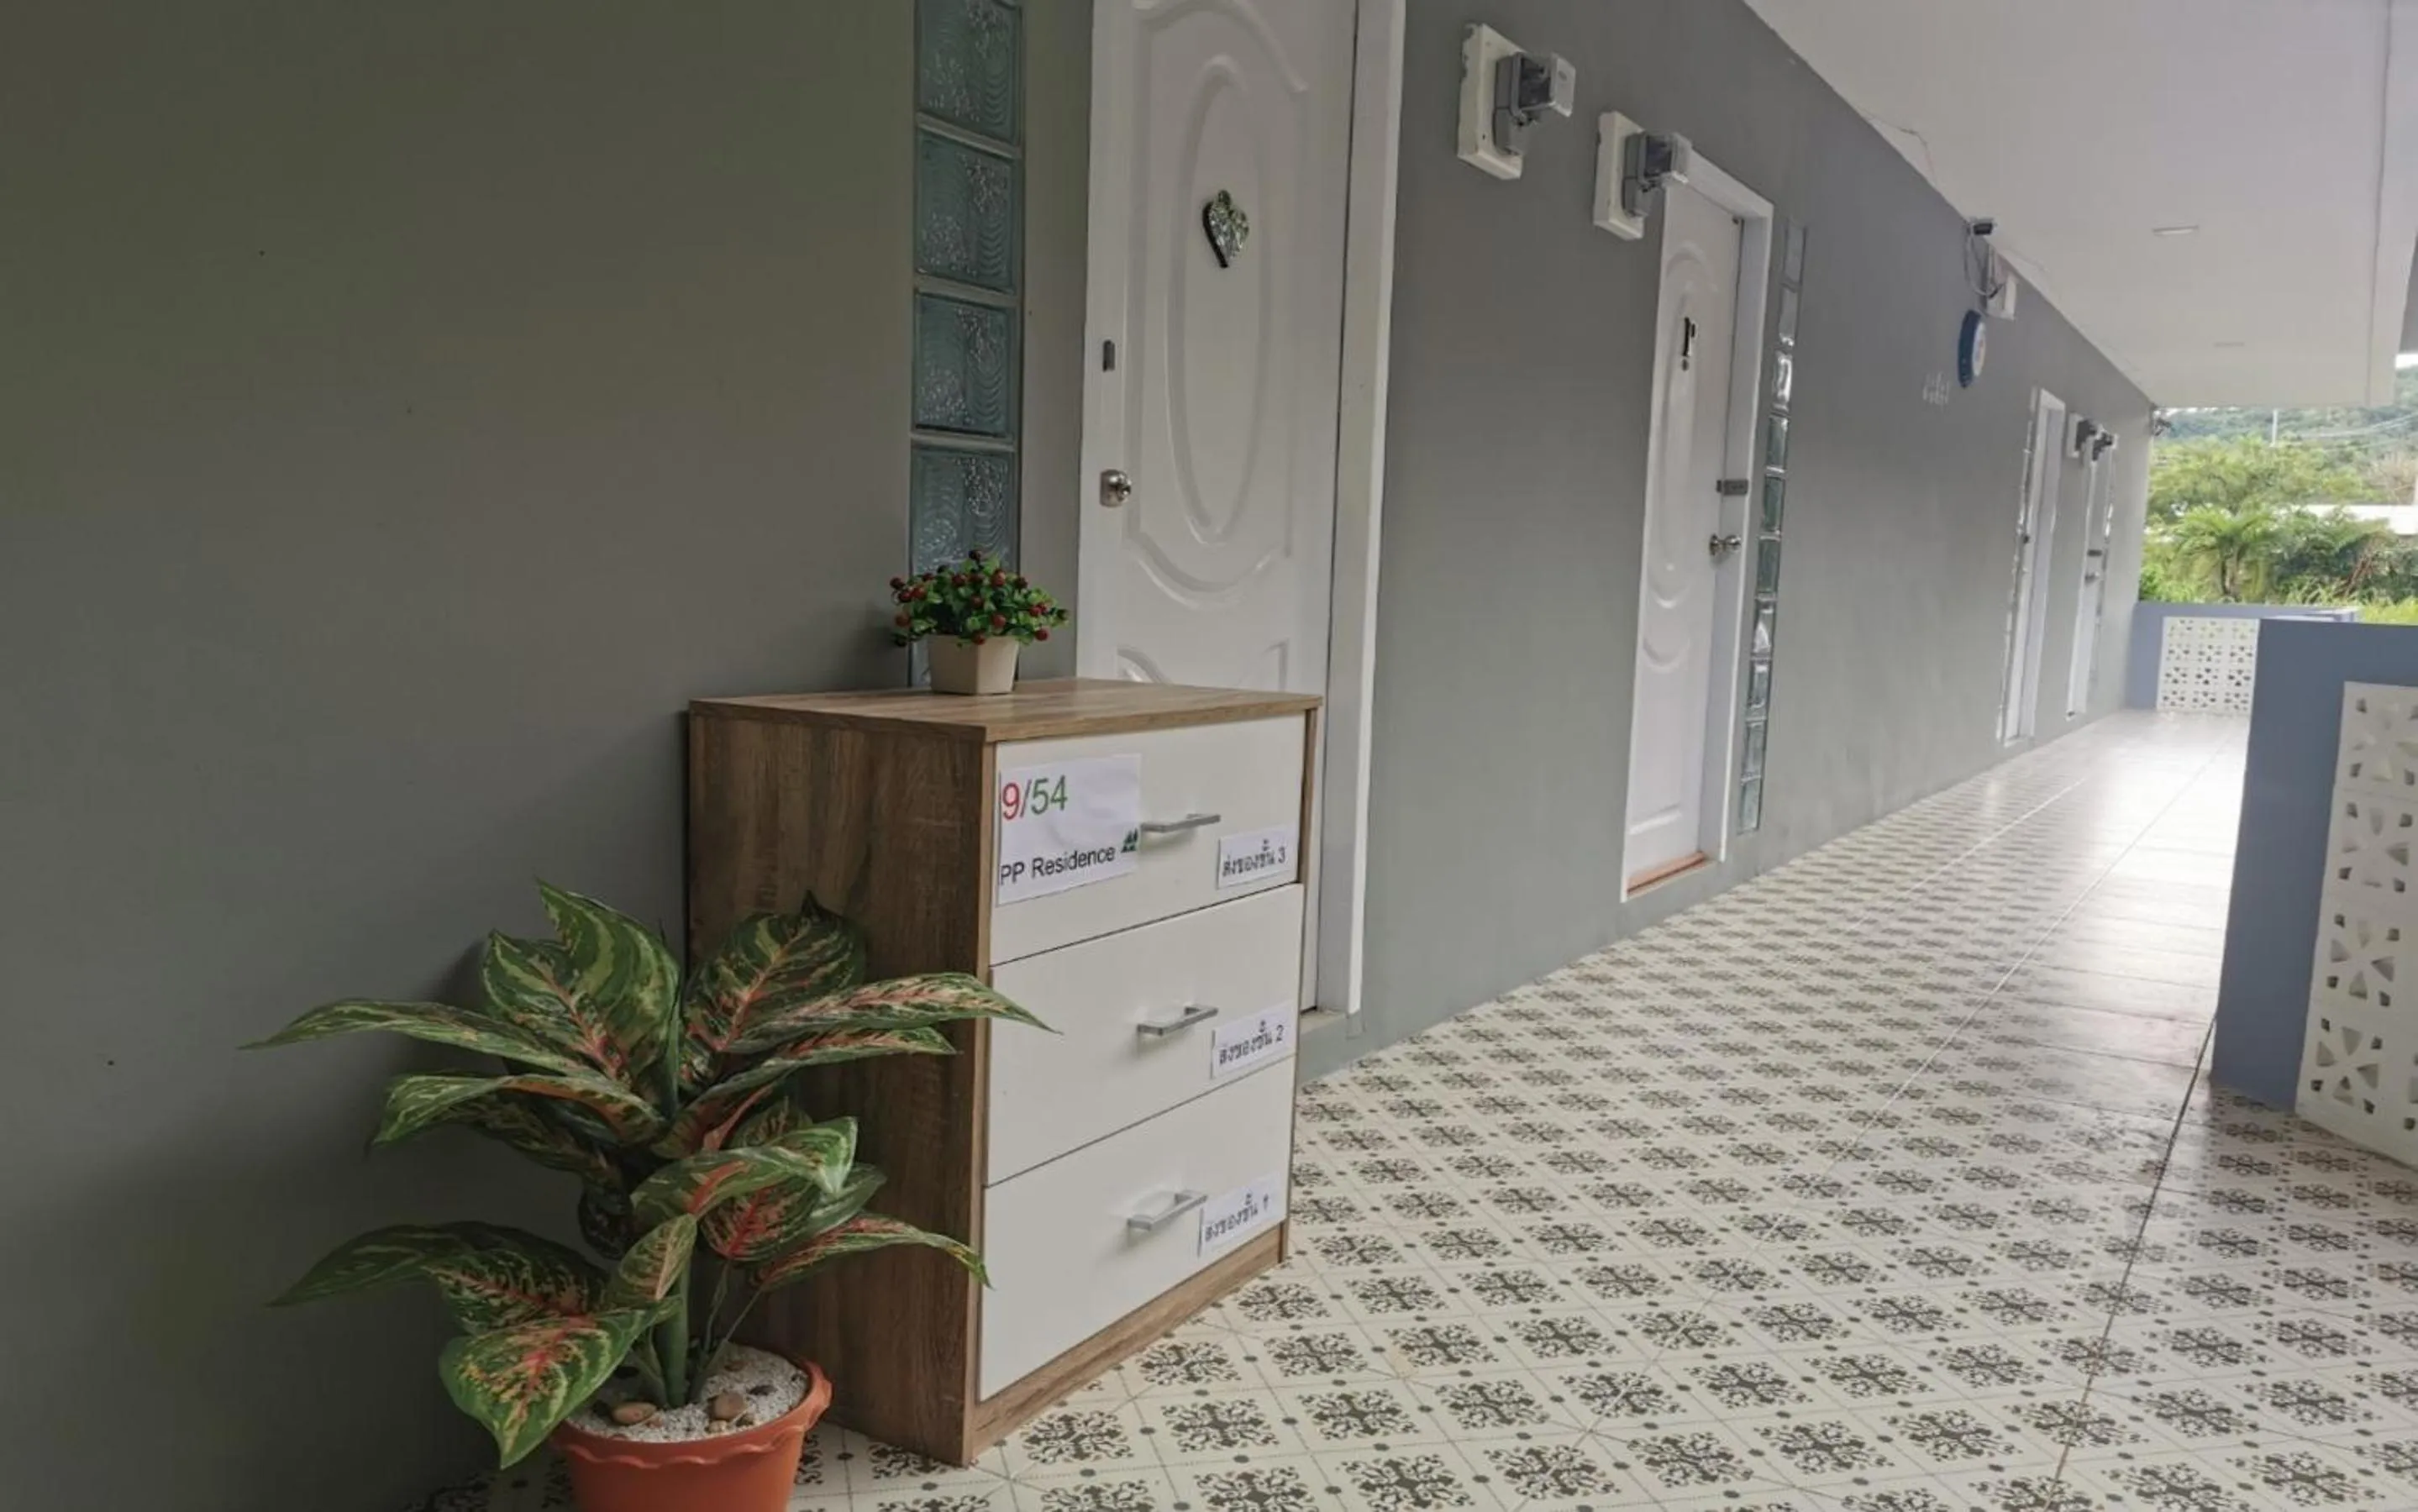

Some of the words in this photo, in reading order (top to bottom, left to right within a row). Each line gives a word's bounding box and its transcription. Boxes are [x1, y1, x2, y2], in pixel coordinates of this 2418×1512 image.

[1001, 774, 1068, 821] 9/54
[1000, 861, 1025, 885] PP
[1032, 846, 1116, 879] Residence
[1277, 845, 1285, 864] 3
[1275, 1024, 1285, 1042] 2
